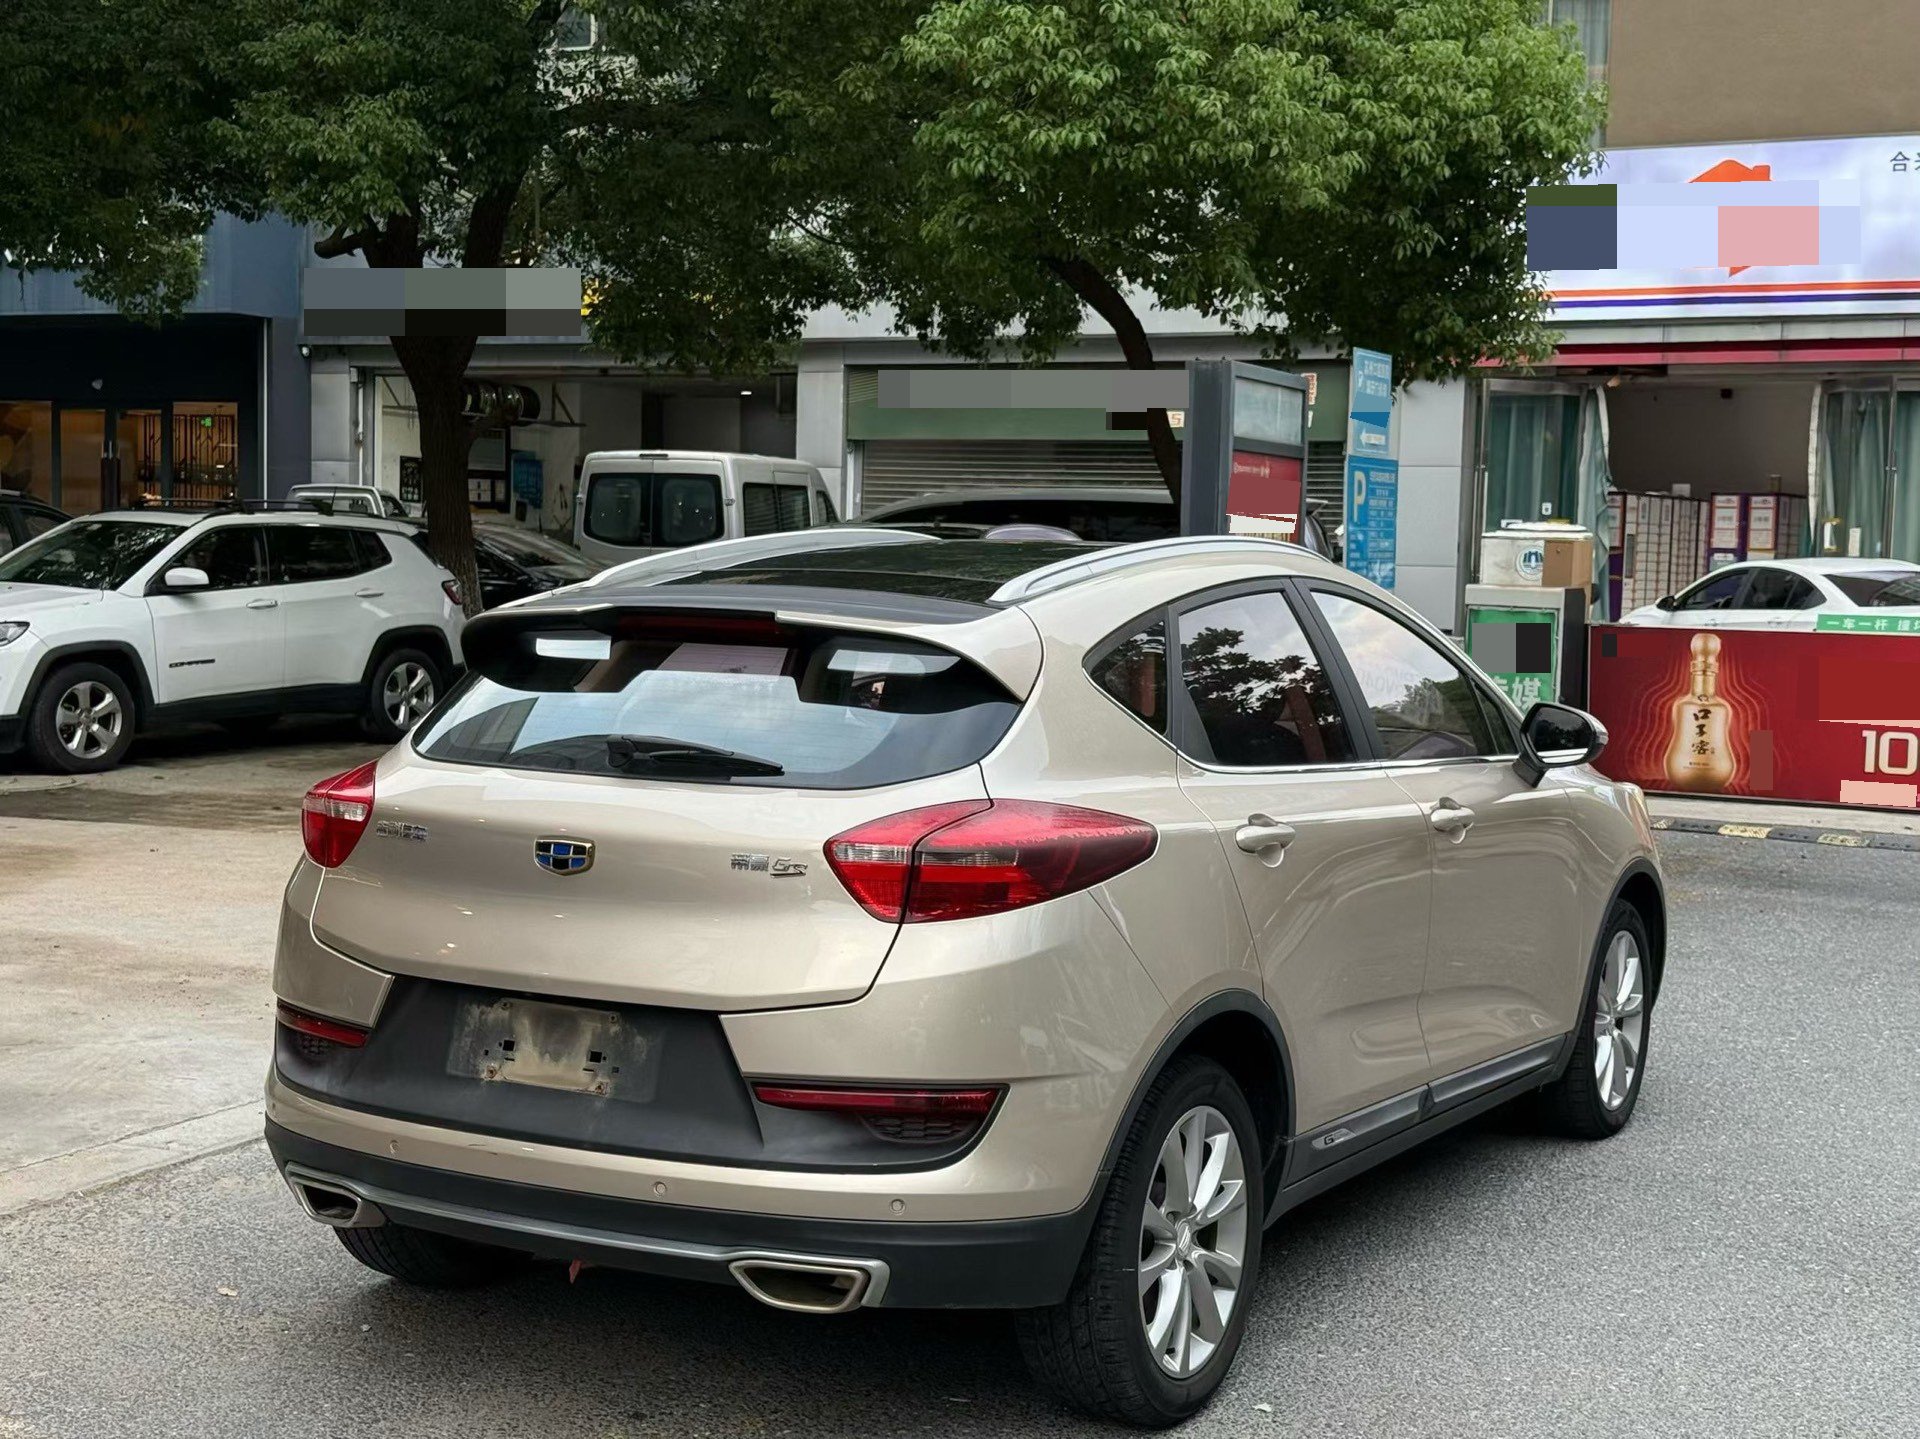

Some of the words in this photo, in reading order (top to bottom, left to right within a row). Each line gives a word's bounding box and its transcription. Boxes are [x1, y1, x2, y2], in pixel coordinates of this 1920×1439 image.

[1353, 471, 1367, 523] P
[1826, 618, 1888, 631] 一车一杆
[1493, 676, 1542, 710] 媒
[1692, 708, 1712, 755] 口子窖
